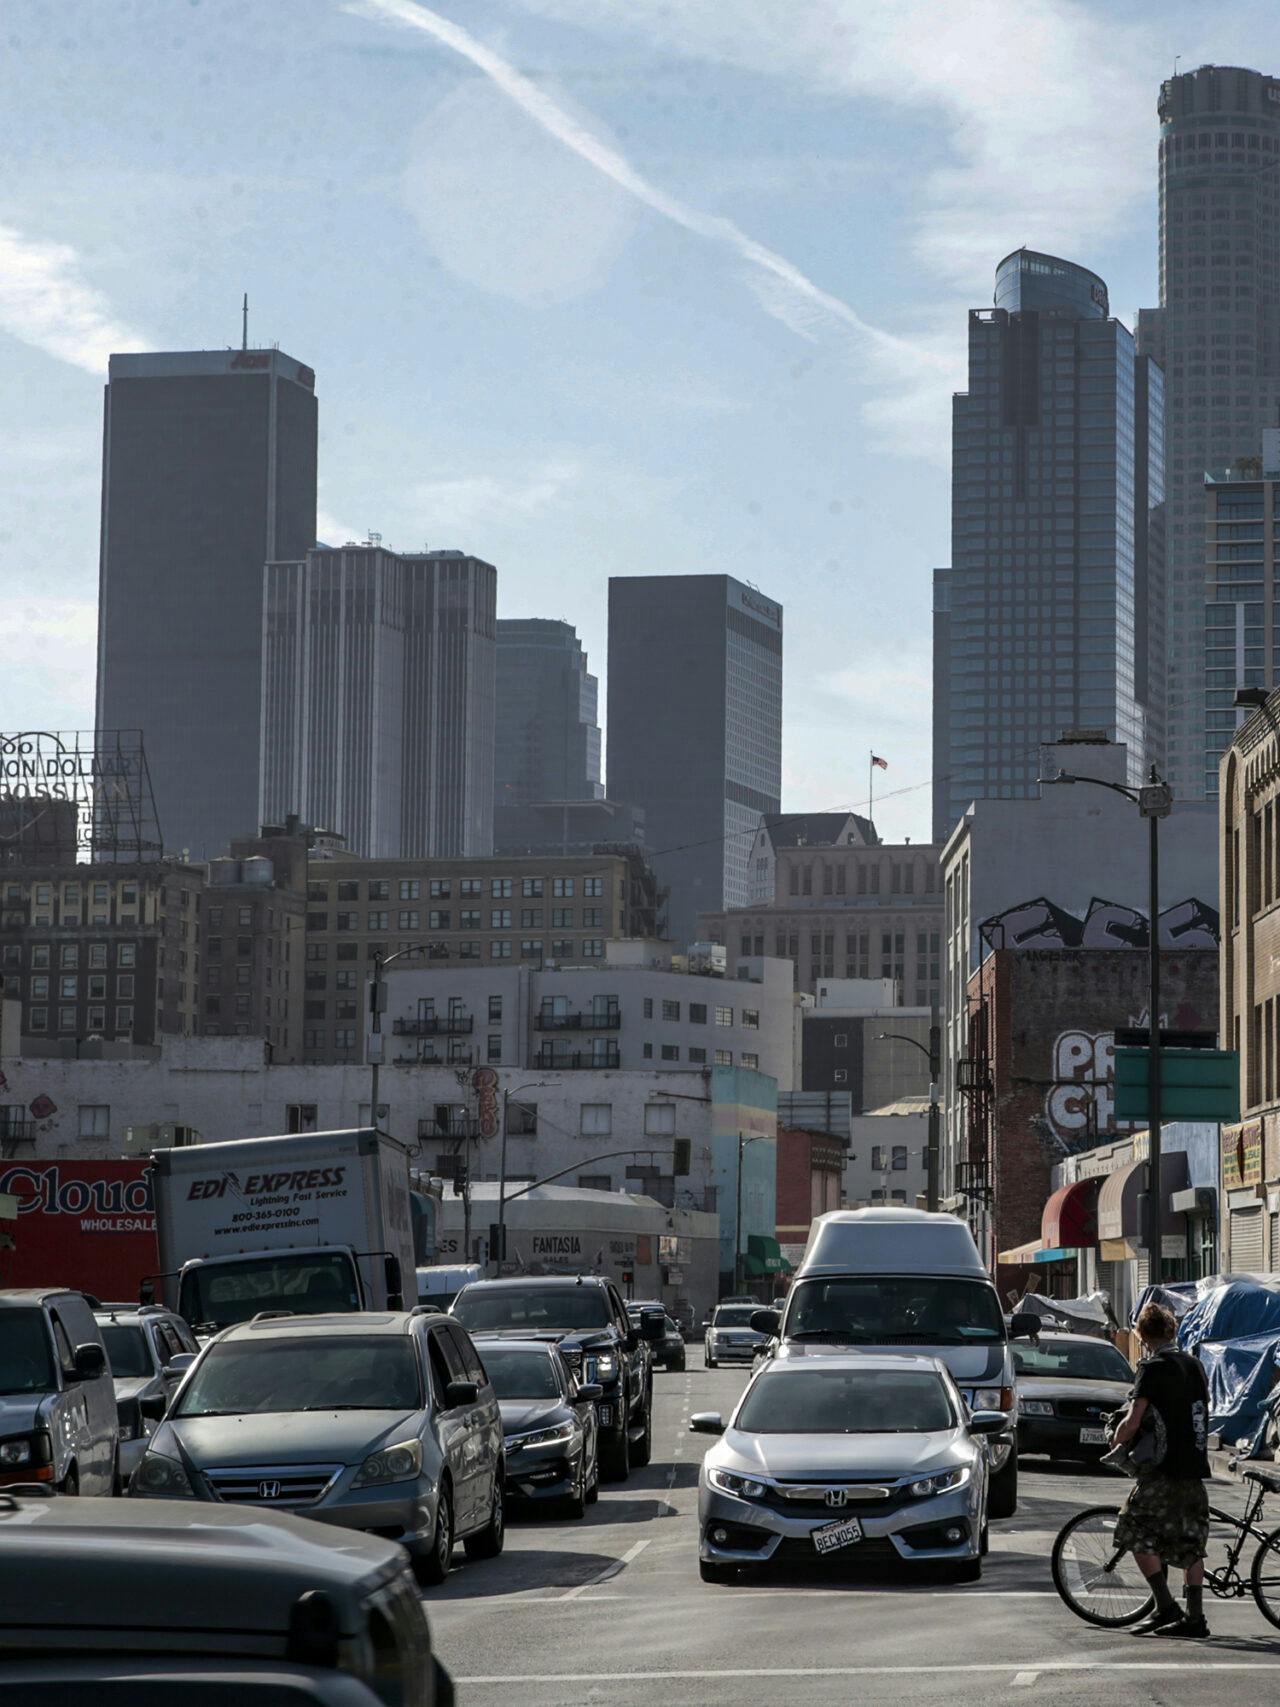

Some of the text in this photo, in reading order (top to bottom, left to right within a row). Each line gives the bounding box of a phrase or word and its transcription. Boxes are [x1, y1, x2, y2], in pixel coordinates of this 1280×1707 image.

[0, 1166, 156, 1215] Cloud
[187, 1166, 346, 1201] EDI EXPRESS
[250, 1188, 348, 1207] Lightning Fast Service
[231, 1207, 301, 1223] 800-365-0100
[80, 1218, 157, 1232] WHOLESALE
[532, 1236, 582, 1254] FANTASIA
